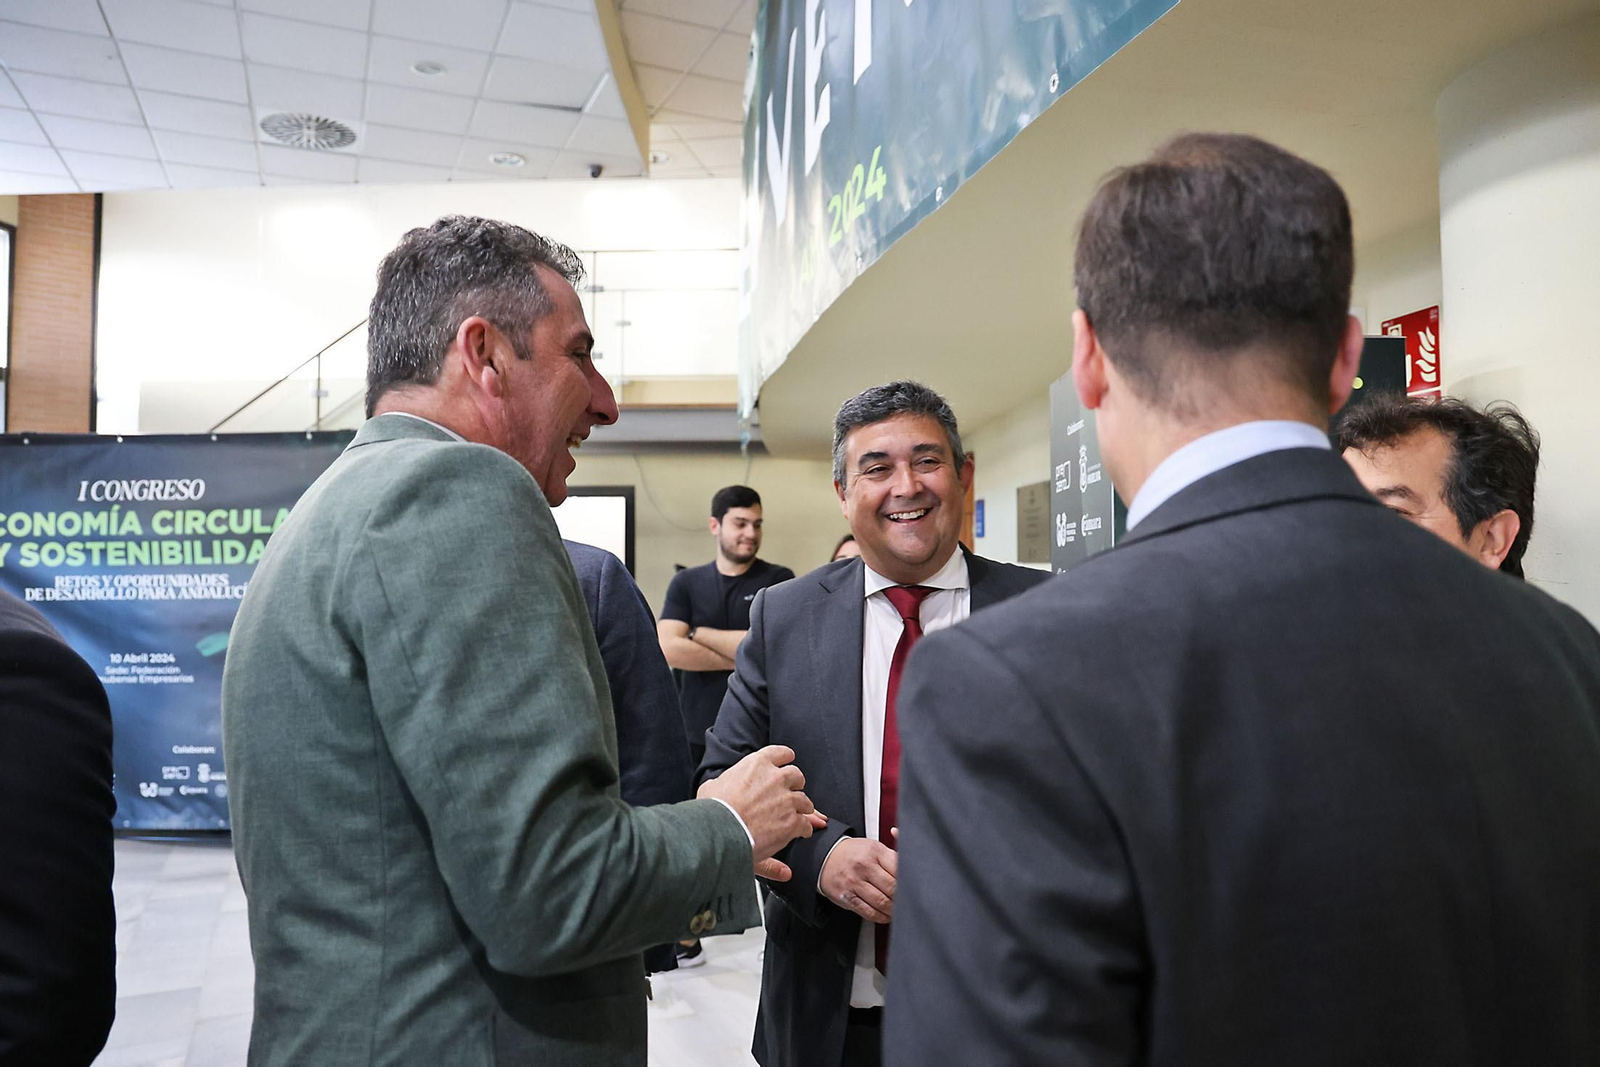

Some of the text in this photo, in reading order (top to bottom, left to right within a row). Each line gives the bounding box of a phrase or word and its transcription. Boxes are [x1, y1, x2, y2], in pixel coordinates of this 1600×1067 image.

[828, 145, 887, 246] 2024
[77, 478, 206, 501] I CONGRESO
[54, 573, 229, 588] RETOS Y OPORTUNIDADES
[25, 588, 44, 601] DE
[45, 586, 138, 601] DESARROLLO
[138, 586, 176, 600] PARA
[110, 653, 176, 664] 10 Abril 2024
[139, 674, 194, 685] Empresarios
